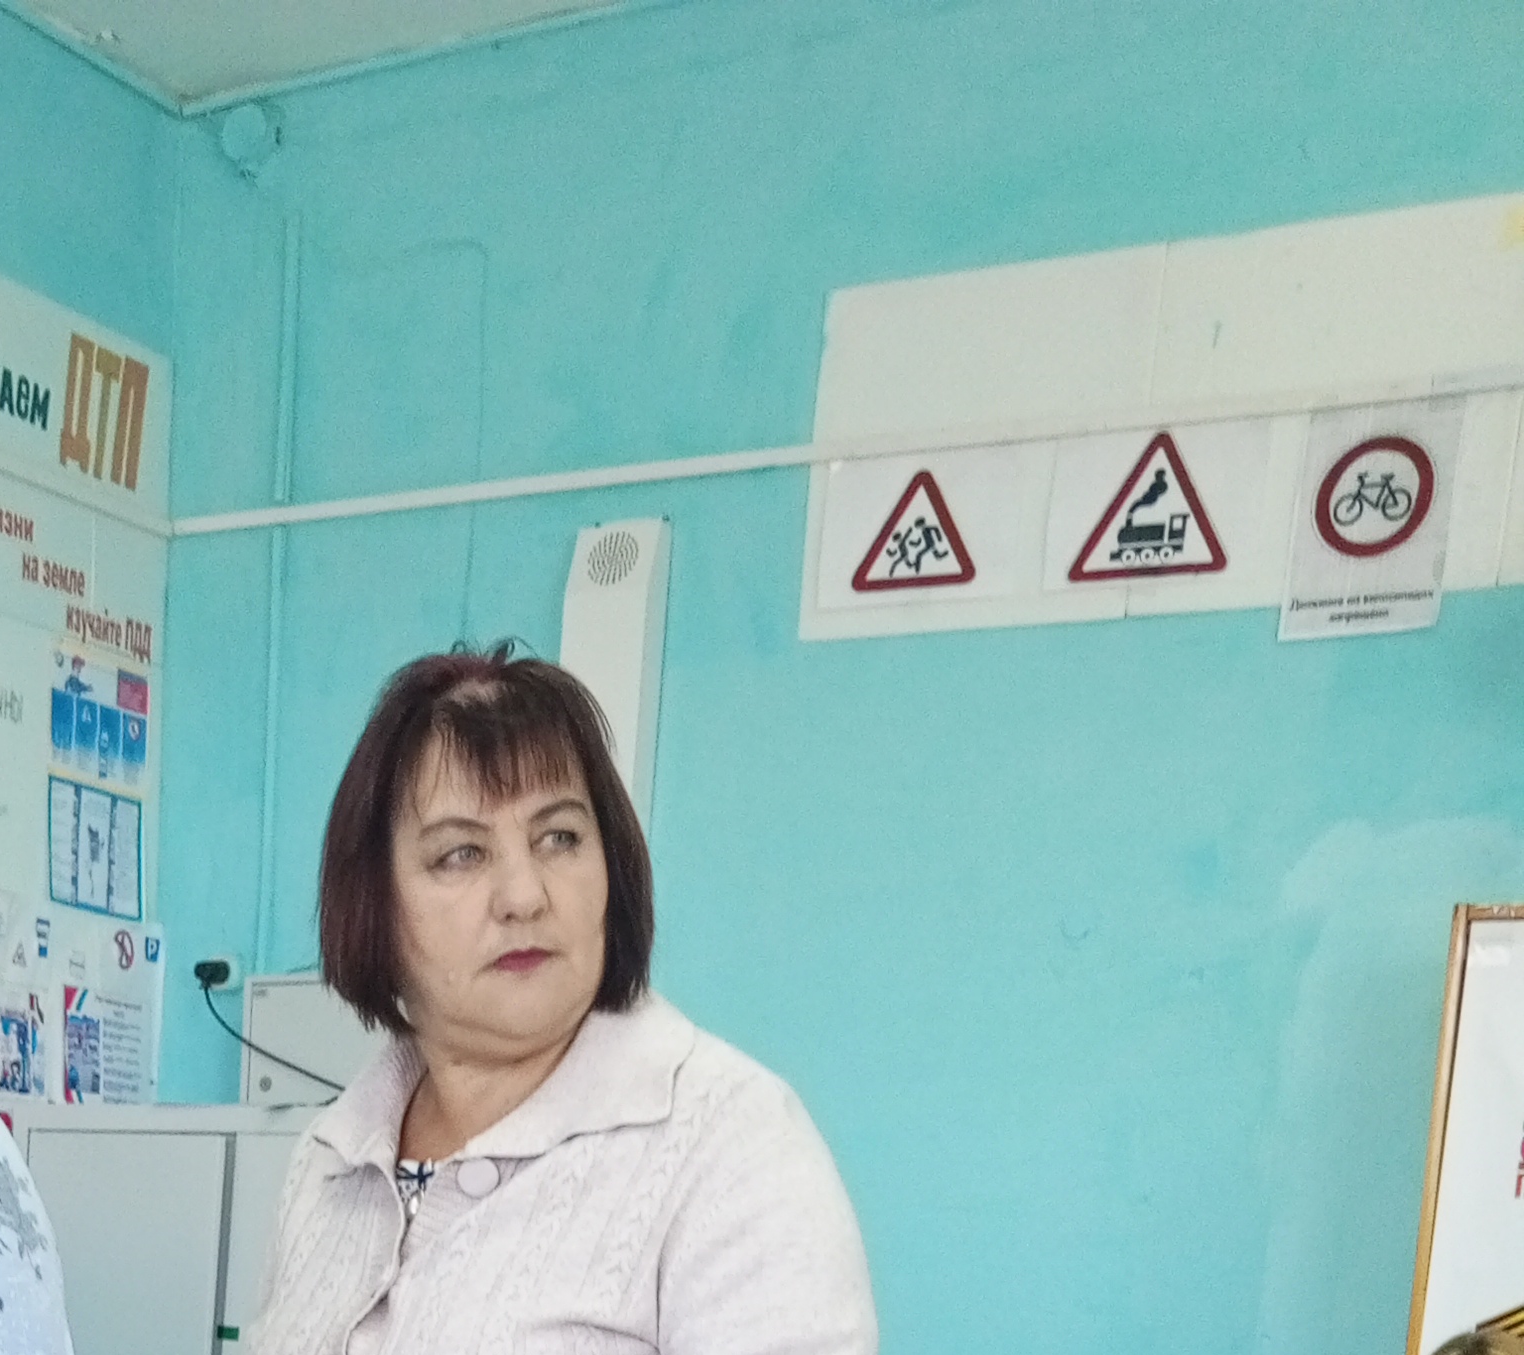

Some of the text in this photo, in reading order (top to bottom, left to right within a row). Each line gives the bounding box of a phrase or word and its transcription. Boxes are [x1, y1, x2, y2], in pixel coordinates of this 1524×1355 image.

[60, 332, 150, 492] ДТП
[42, 558, 86, 598] земле
[125, 617, 153, 666] ПДД
